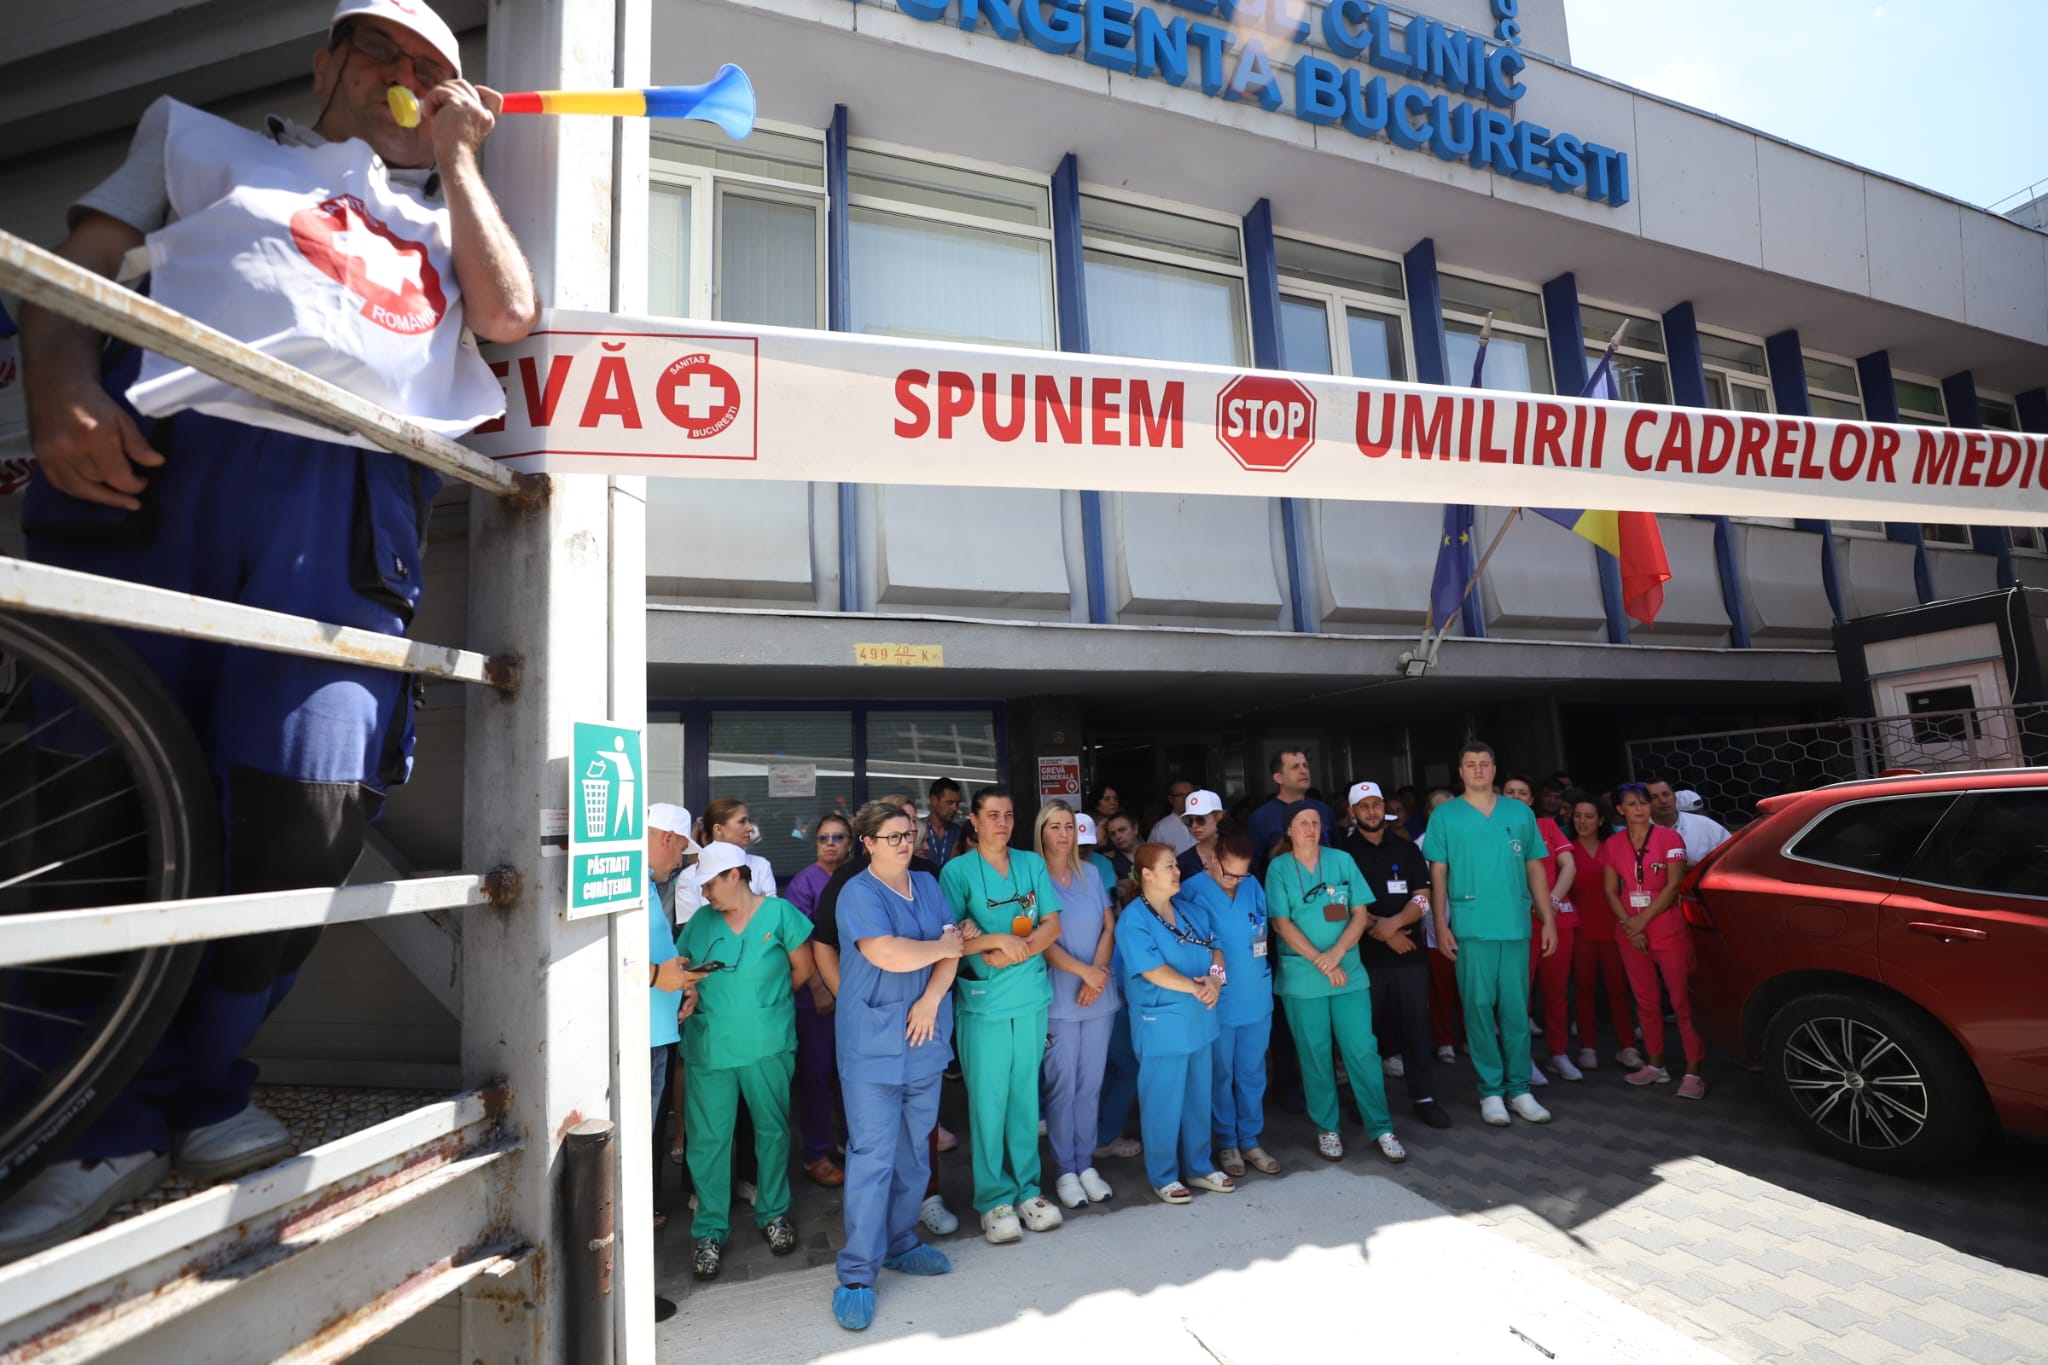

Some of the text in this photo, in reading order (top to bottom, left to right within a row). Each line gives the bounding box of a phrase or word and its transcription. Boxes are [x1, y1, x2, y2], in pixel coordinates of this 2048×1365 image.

[894, 0, 1631, 208] GENTA BUCURESTI
[1322, 0, 1527, 107] CLINIC
[669, 355, 706, 375] SANITAS
[894, 368, 1185, 449] SPUNEM
[1227, 398, 1305, 441] STOP
[1355, 391, 1608, 469] UMILIRII
[1623, 409, 1902, 484] CADRELOR
